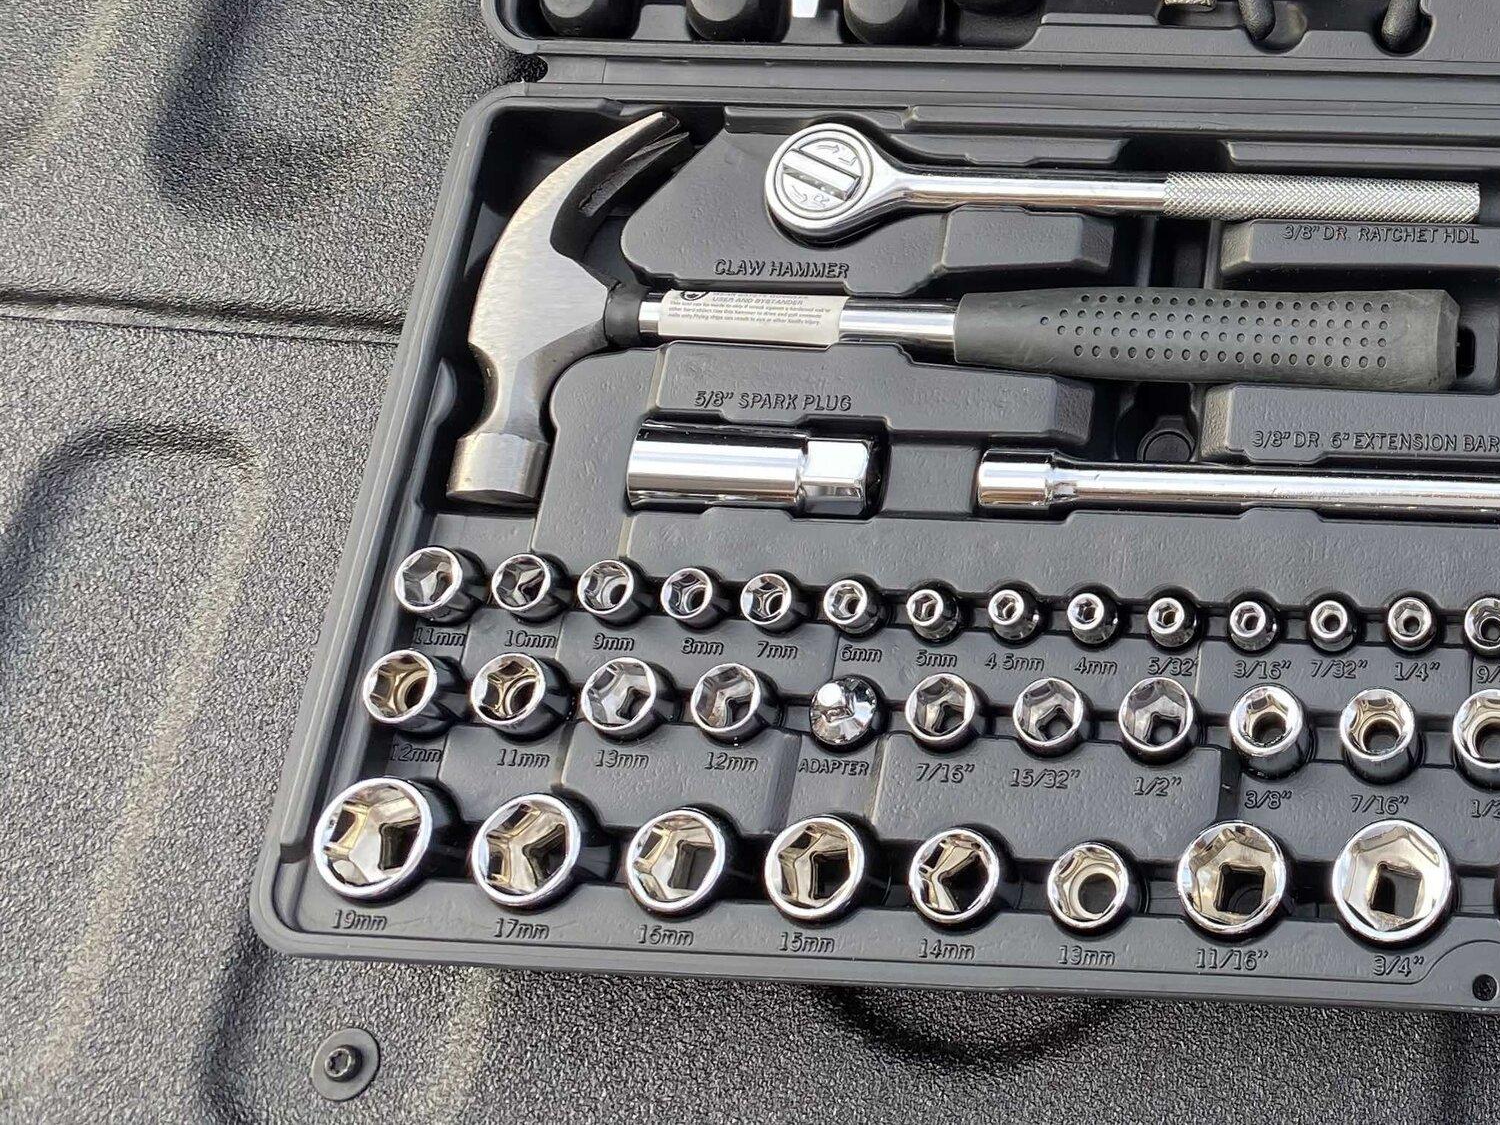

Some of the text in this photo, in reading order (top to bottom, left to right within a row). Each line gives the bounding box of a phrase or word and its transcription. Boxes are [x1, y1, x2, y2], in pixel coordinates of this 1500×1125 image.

[1282, 225, 1320, 240] 3/8"
[1358, 226, 1439, 244] RATCHET
[1443, 228, 1480, 244] HDL
[714, 258, 851, 279] CLAW HAMMER
[738, 392, 799, 411] SPARK
[802, 394, 852, 412] PLUG
[1252, 430, 1291, 448] 3/8"
[1353, 432, 1457, 452] EXTENSION
[1462, 435, 1500, 453] BAR
[504, 630, 556, 649] 10mm
[592, 636, 635, 651] 9mm
[681, 639, 724, 655] 8mm
[756, 641, 798, 660] 7mm
[840, 644, 882, 662] 6mm
[915, 649, 958, 667] 5mm
[1074, 657, 1118, 675] 4mm
[1233, 659, 1292, 679] 3/16"
[1311, 659, 1368, 679] 7/32"
[1395, 662, 1441, 681] 1/4"
[389, 743, 442, 763] 12mm
[497, 748, 550, 768] 11mm
[595, 750, 649, 769] 13mm
[704, 752, 758, 772] 12mm
[799, 758, 869, 776] ADAPTER
[916, 763, 976, 783] 7/16"
[1010, 768, 1081, 789] 15/32"
[1133, 777, 1182, 796] 1/2"
[1245, 790, 1292, 809] 3/8"
[1351, 795, 1409, 815] 7/16"
[331, 909, 388, 931] 19mm
[493, 917, 551, 940] 17mm
[778, 931, 836, 954] 15mm
[918, 938, 976, 961] 14mm
[1058, 944, 1116, 966] 13mm
[1195, 947, 1269, 971] 11/16"
[1373, 954, 1425, 977] 3/4"
